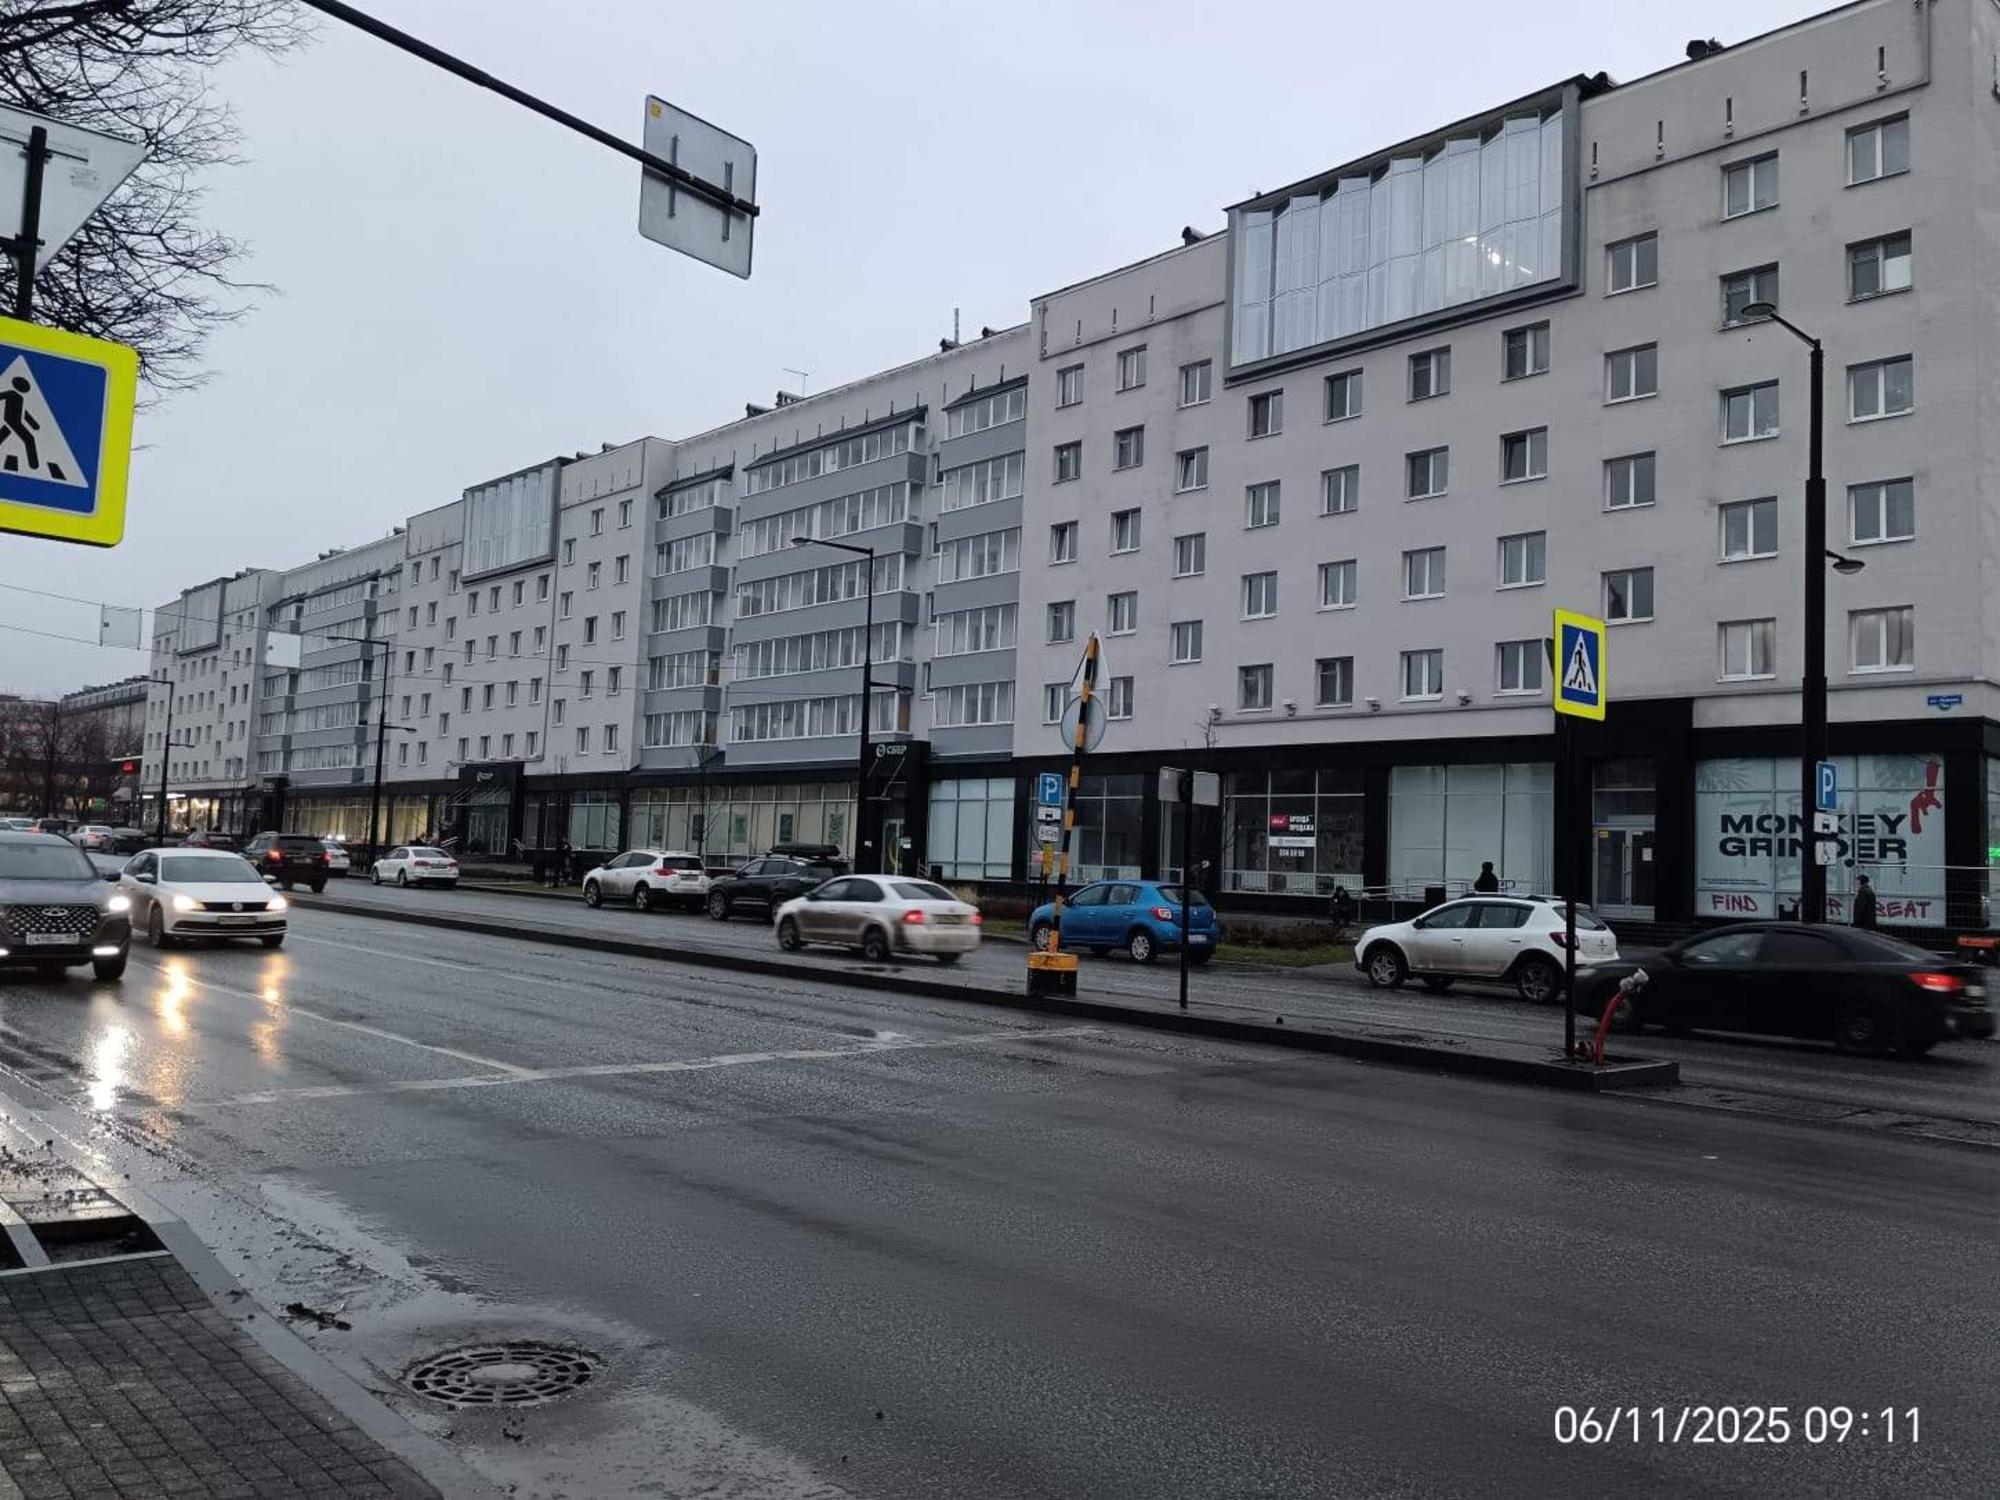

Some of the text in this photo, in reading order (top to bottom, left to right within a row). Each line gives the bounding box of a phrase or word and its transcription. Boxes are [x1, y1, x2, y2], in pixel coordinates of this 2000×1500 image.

[1047, 776, 1058, 802] P
[1823, 767, 1834, 805] P
[1711, 894, 1759, 913] FIND
